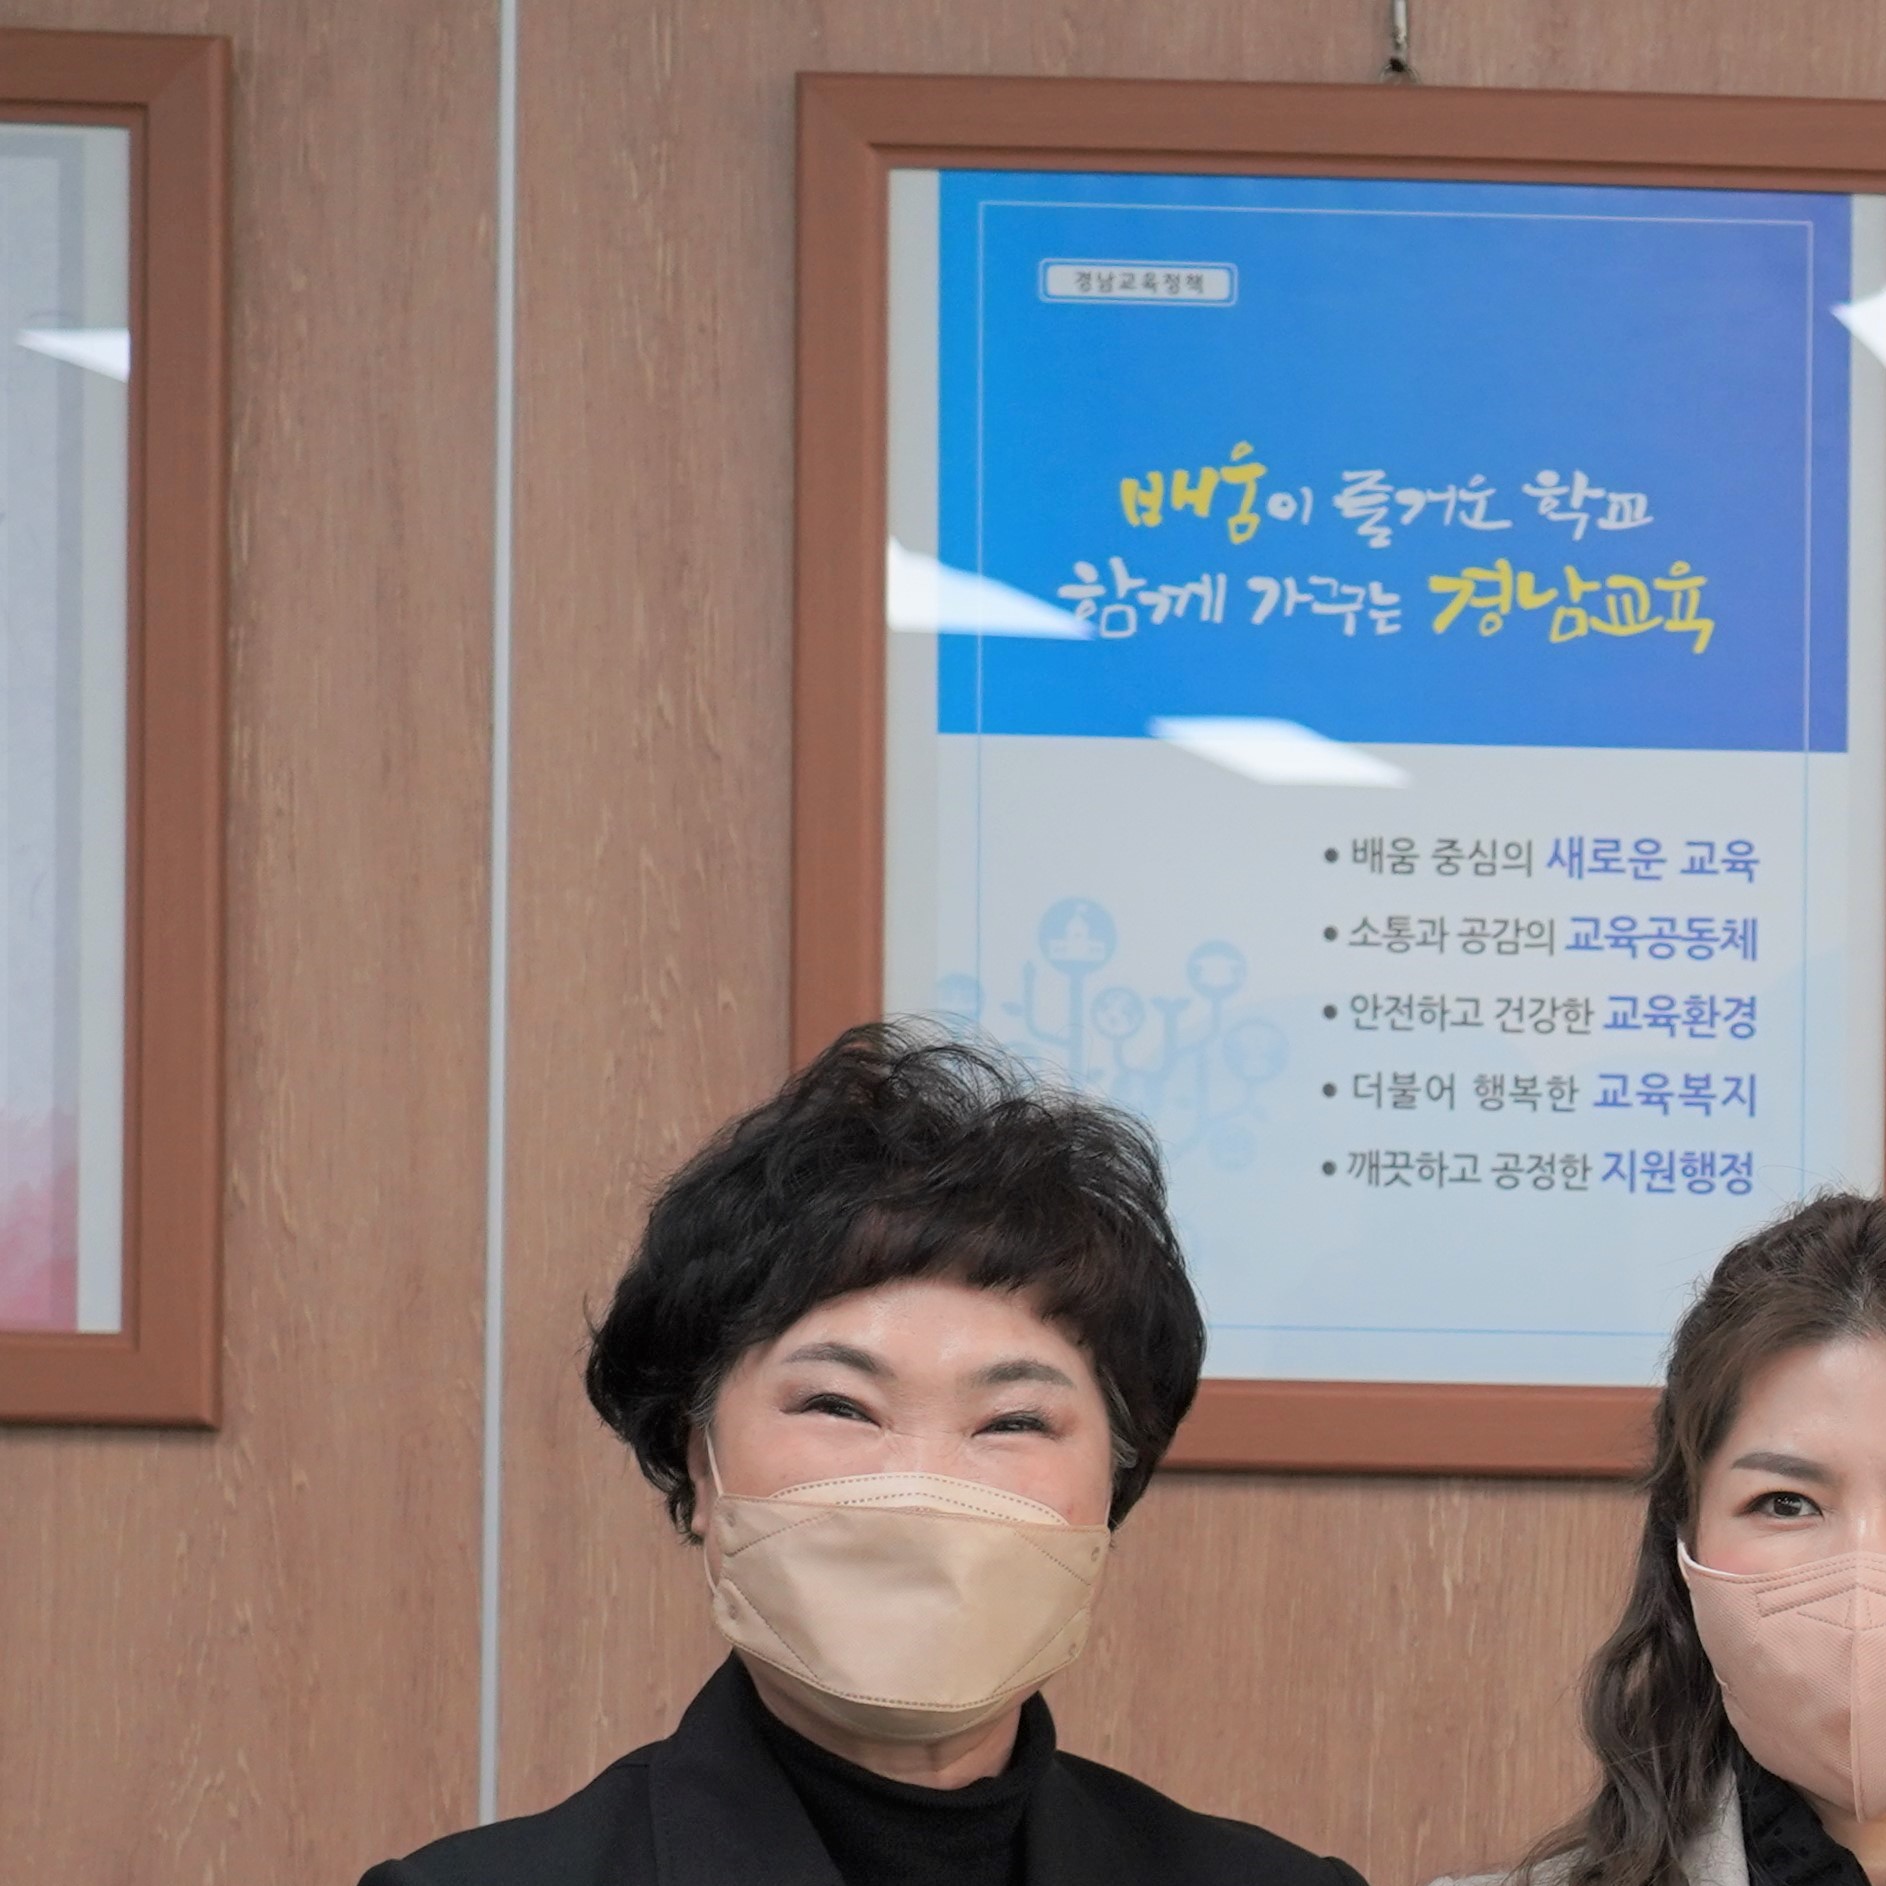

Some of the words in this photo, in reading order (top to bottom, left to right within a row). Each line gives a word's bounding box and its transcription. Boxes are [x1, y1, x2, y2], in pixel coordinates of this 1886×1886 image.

[1073, 270, 1206, 295] 경남교육정책
[1120, 442, 1312, 544] 배움이
[1333, 469, 1512, 548] 즐거운
[1522, 470, 1653, 540] 학교
[1058, 558, 1225, 637] 함께
[1247, 576, 1401, 636] 가꾸는
[1428, 558, 1714, 653] 경남교육
[1352, 837, 1420, 875] 배움
[1431, 838, 1532, 877] 중심의
[1547, 836, 1667, 880] 새로운
[1680, 839, 1760, 883] 교육
[1348, 916, 1449, 954] 소통과
[1457, 917, 1554, 956] 공감의
[1565, 916, 1757, 961] 교육공동체
[1350, 994, 1484, 1032] 안전하고
[1495, 996, 1594, 1035] 건강한
[1603, 995, 1756, 1040] 교육환경
[1353, 1072, 1454, 1110] 더불어
[1474, 1074, 1579, 1112] 행복한
[1593, 1073, 1756, 1117] 교육복지
[1347, 1150, 1481, 1188] 깨끗하고
[1491, 1153, 1592, 1191] 공정한
[1602, 1150, 1752, 1195] 지원행정
